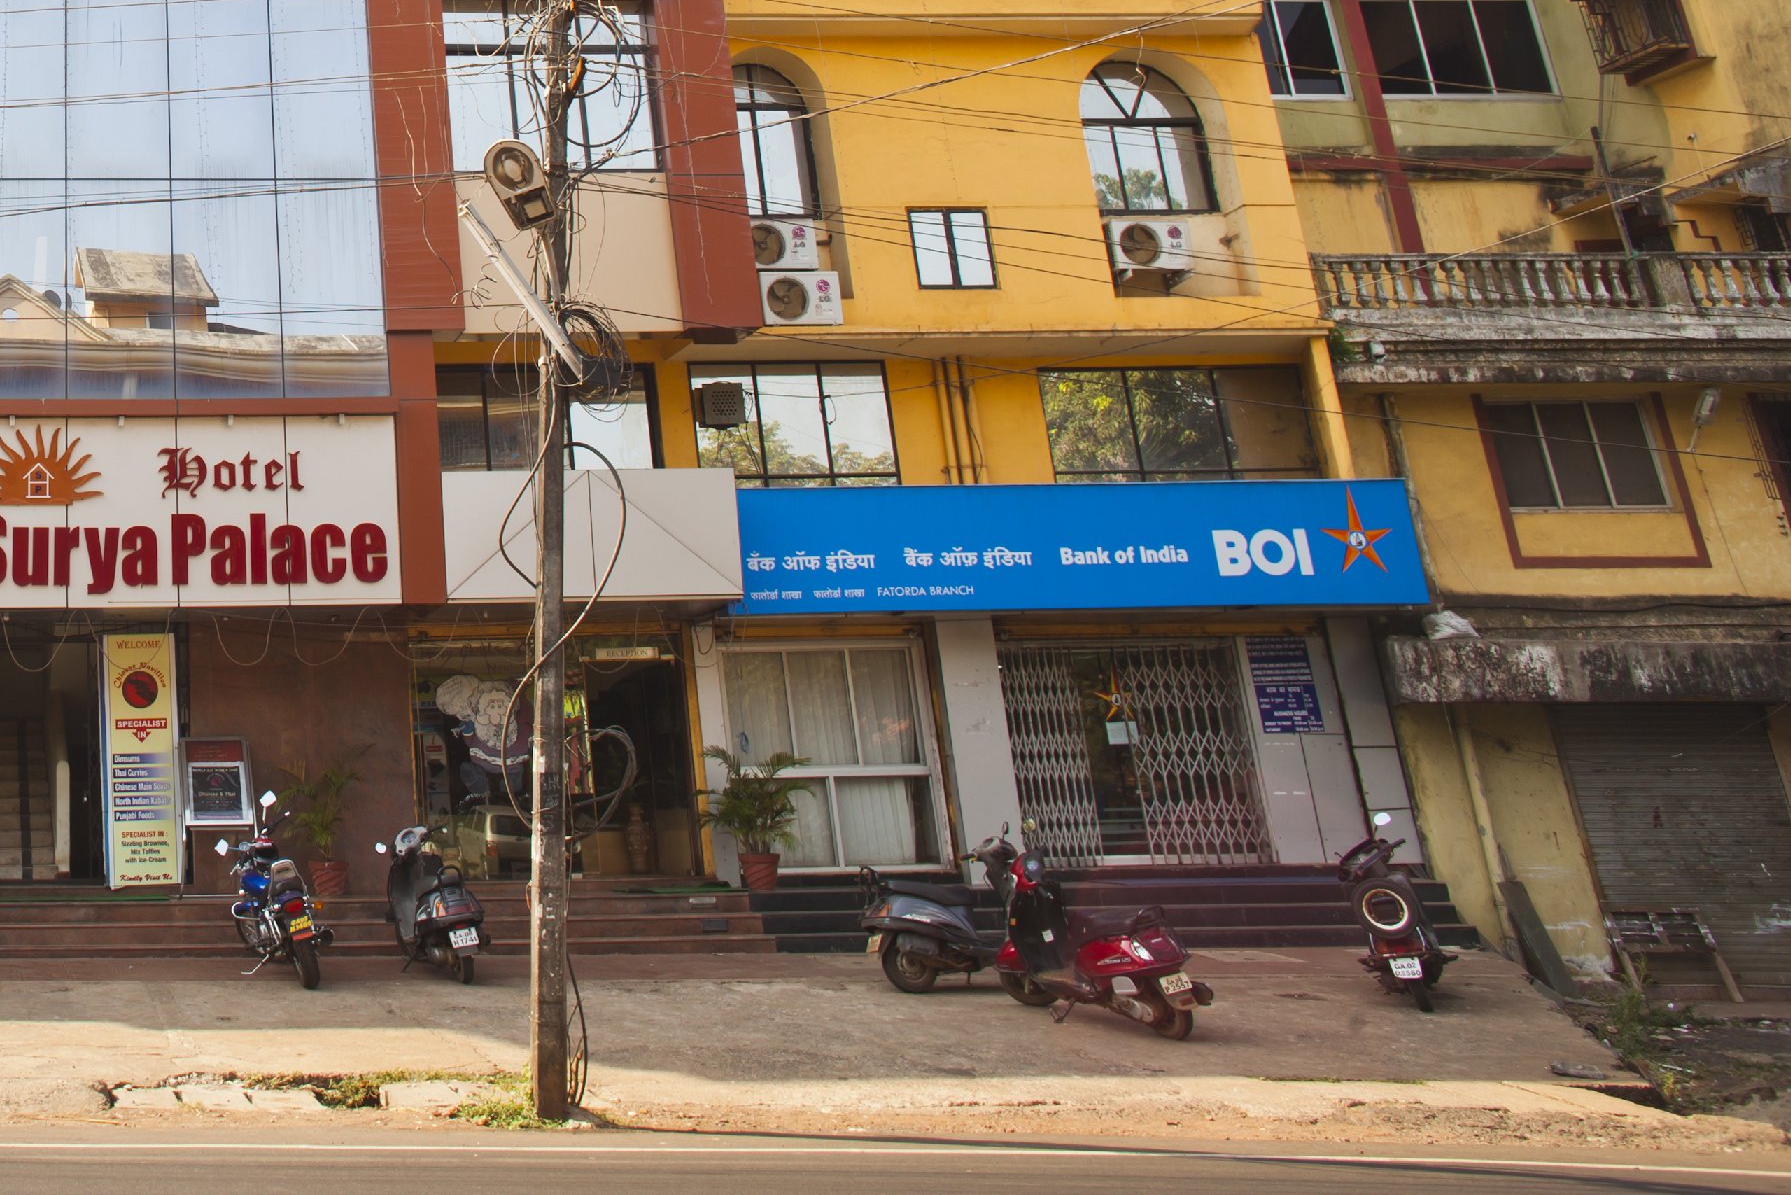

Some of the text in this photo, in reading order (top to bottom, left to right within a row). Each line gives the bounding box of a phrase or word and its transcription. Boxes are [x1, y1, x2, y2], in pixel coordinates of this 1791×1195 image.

[818, 295, 831, 303] LG
[35, 470, 42, 480] S
[157, 446, 305, 498] Hotel
[35, 485, 42, 494] P
[171, 512, 388, 586] Palace
[1211, 528, 1315, 577] BOI
[903, 547, 933, 567] बैंक
[983, 546, 1033, 569] इंडिया
[1060, 544, 1189, 565] Bank of India
[825, 549, 876, 573] इंडिया
[877, 585, 975, 597] FATORDA BRANCH
[116, 640, 161, 650] WELCOME
[117, 719, 167, 728] SPECIALIST
[137, 730, 147, 738] IN
[115, 783, 137, 791] Chinese
[132, 797, 150, 805] Indian
[116, 811, 155, 820] Punjabi Foods
[119, 874, 143, 882] Kindly
[144, 873, 161, 881] Visit
